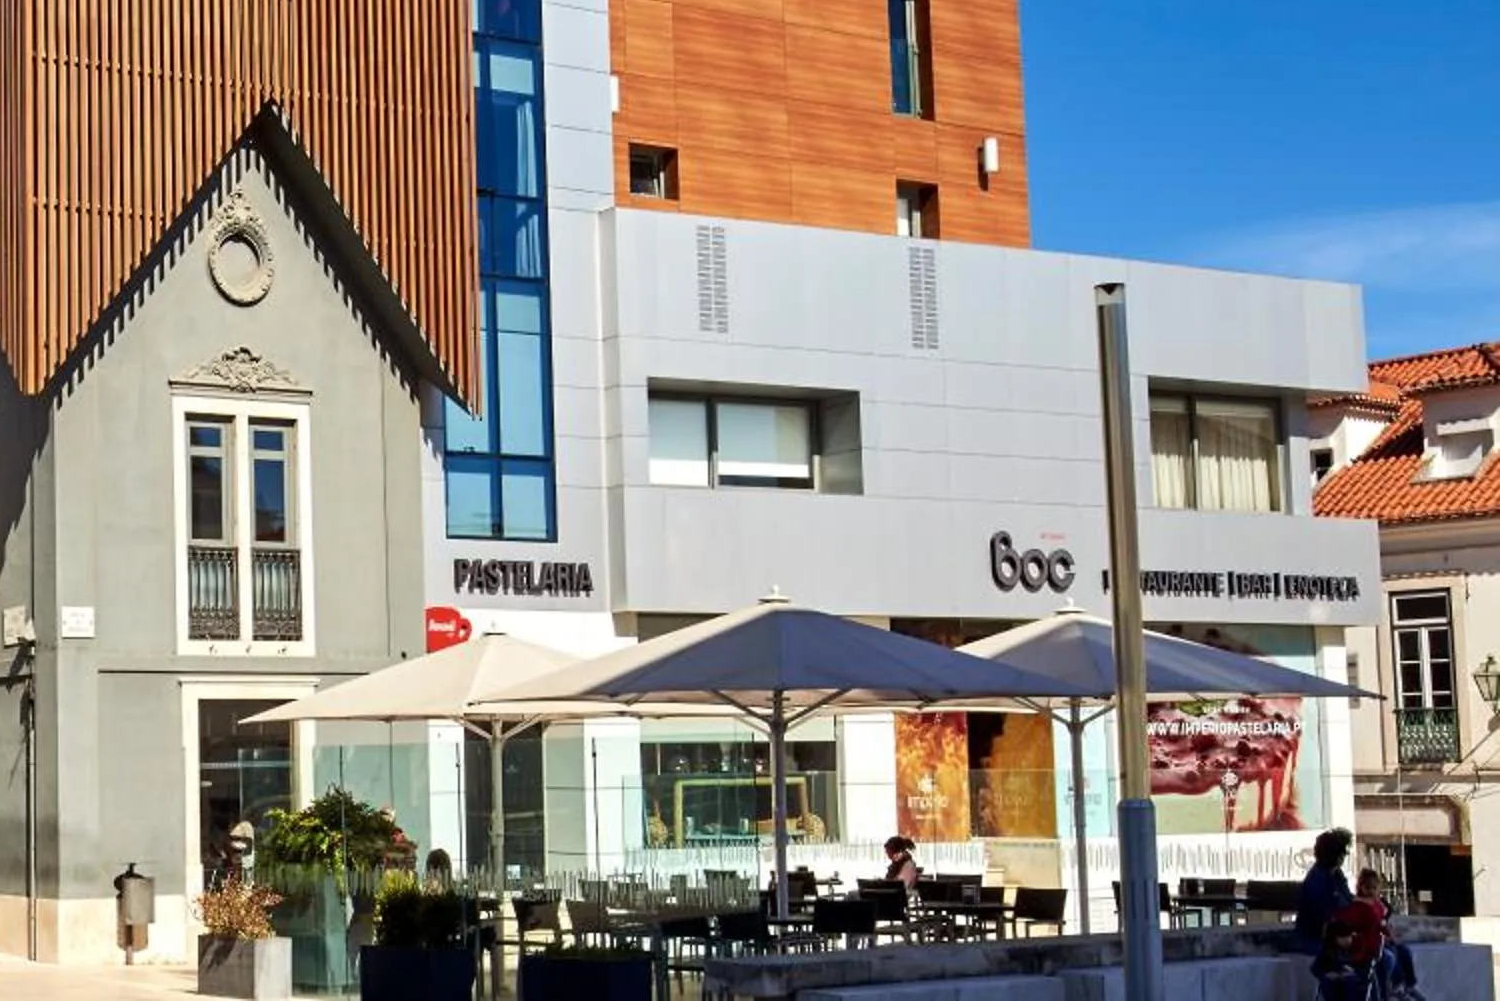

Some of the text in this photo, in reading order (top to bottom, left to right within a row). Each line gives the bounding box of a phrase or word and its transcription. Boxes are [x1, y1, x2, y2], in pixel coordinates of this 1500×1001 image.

[454, 559, 593, 597] PASTELARIA
[990, 531, 1076, 593] boc
[1102, 570, 1225, 598] TAURANTE
[1236, 572, 1274, 599] BAR
